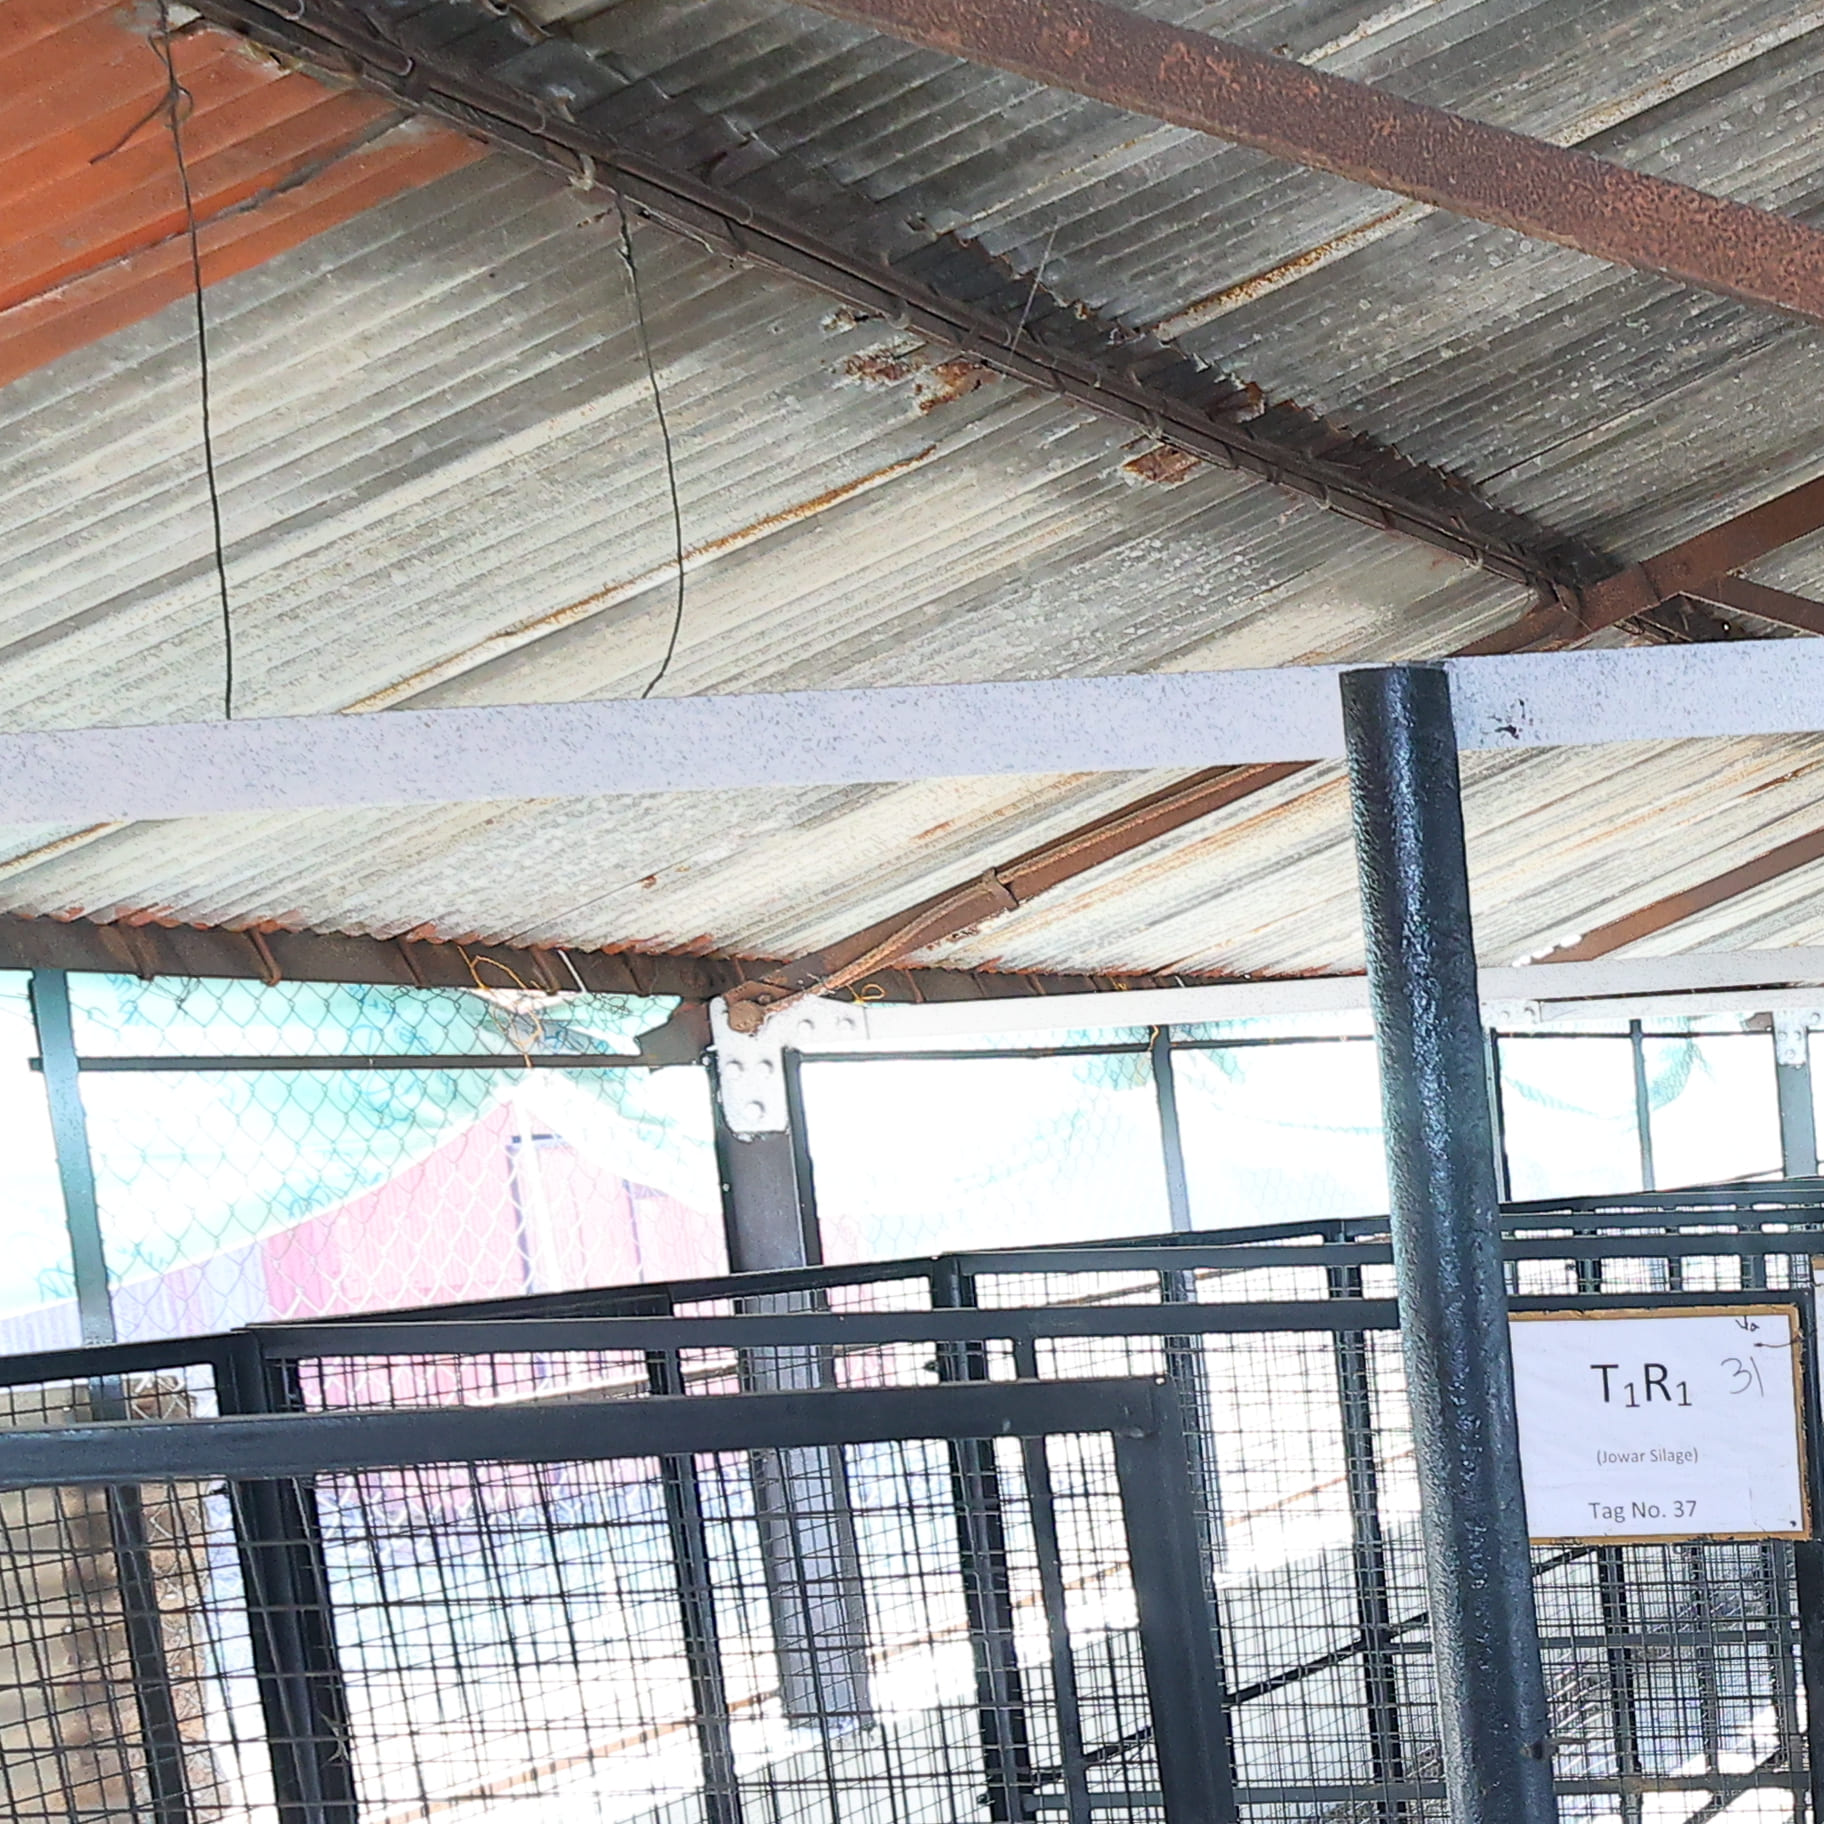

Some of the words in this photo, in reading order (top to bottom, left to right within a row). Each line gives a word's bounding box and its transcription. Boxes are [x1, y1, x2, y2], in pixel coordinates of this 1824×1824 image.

[1596, 1450, 1645, 1467] (Jowar
[1650, 1448, 1699, 1465] Silage)
[1588, 1502, 1626, 1524] Tag
[1631, 1501, 1667, 1519] No.
[1673, 1500, 1697, 1518] 37
